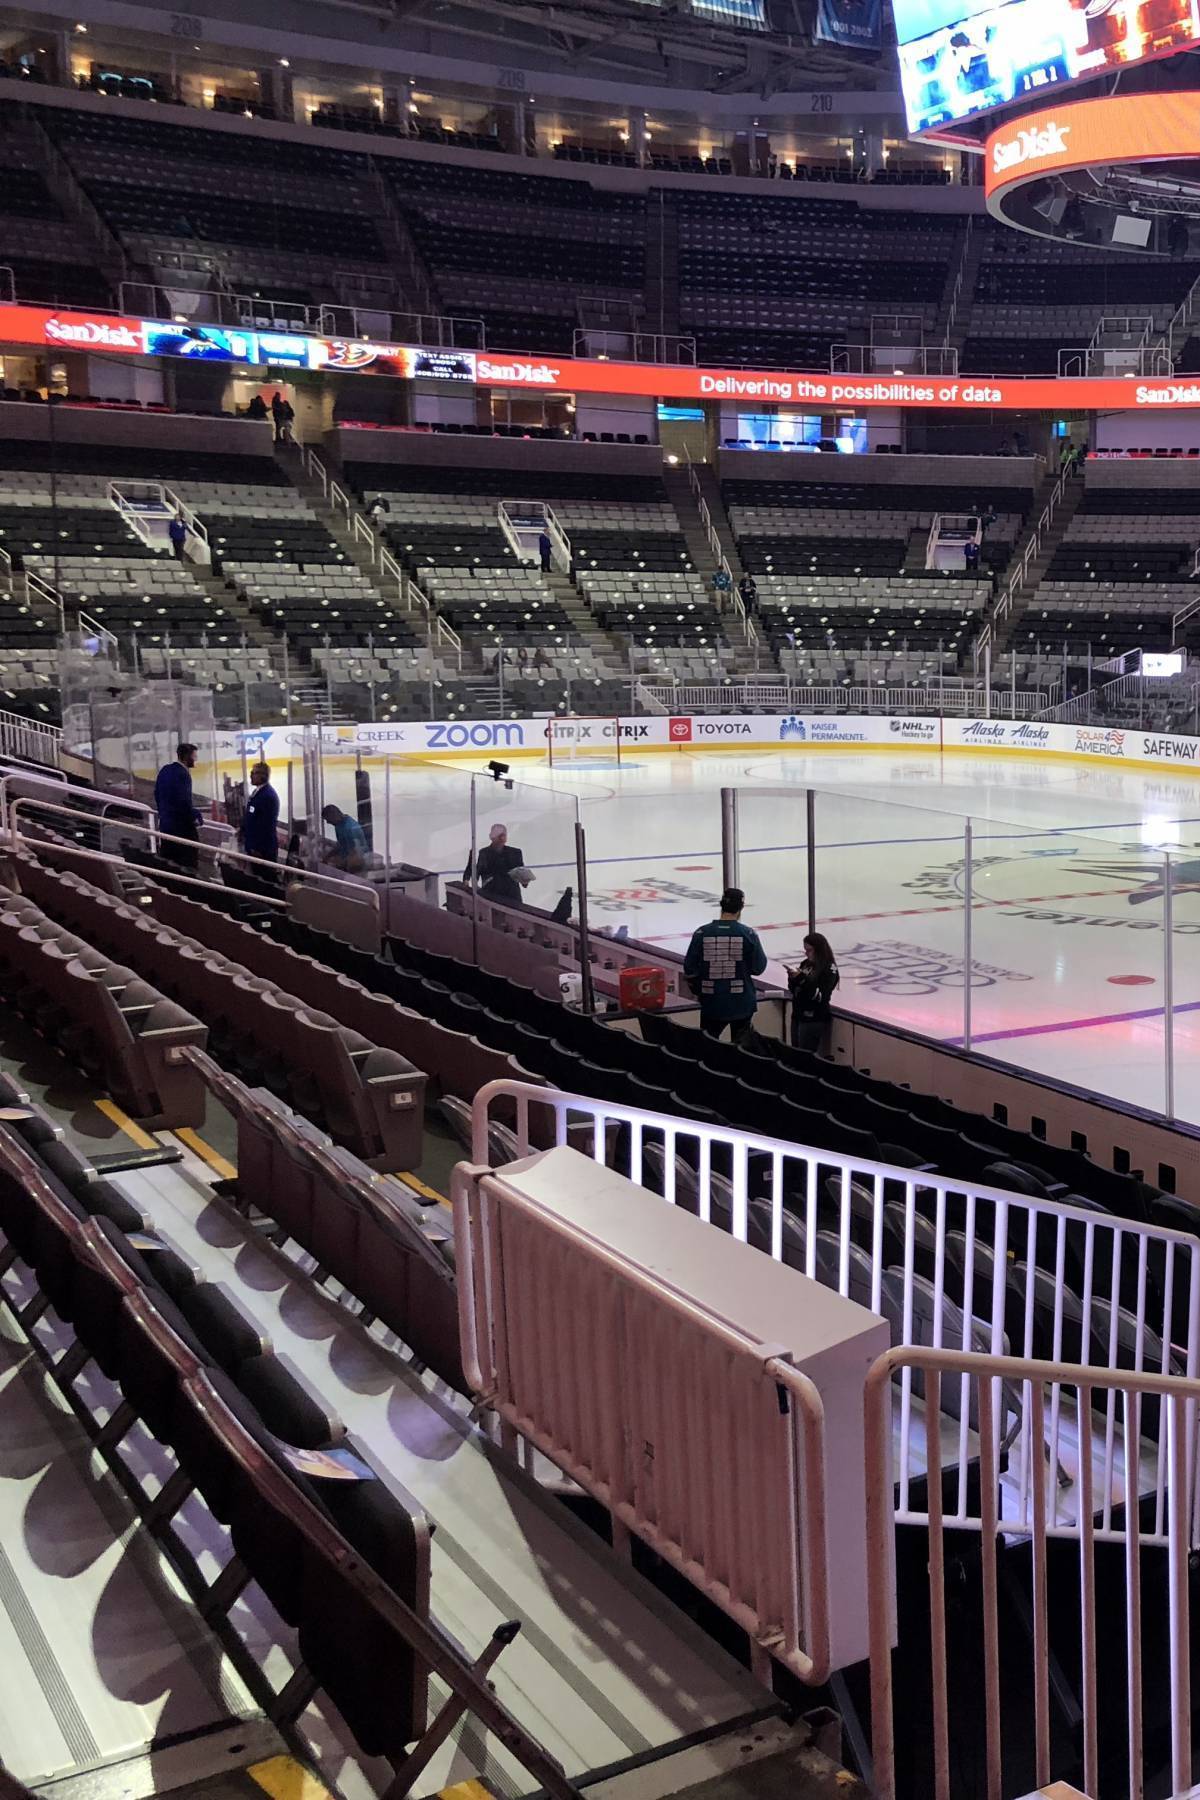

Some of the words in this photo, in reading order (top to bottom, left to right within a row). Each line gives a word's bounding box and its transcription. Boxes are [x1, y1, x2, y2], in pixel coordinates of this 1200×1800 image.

[811, 94, 833, 113] 210
[993, 122, 1069, 173] SanDisk
[45, 320, 141, 347] SanDisk
[478, 360, 558, 383] SanDisk
[700, 376, 791, 398] Delivering
[798, 380, 827, 397] the
[832, 384, 934, 401] possibilities
[939, 386, 958, 401] of
[962, 386, 1002, 402] data
[425, 723, 524, 747] zoom
[697, 723, 751, 734] TOYOTA
[811, 723, 838, 731] KAISER
[962, 721, 1005, 737] Alaska
[1011, 724, 1050, 740] Alaska
[357, 731, 405, 741] CREEK
[811, 732, 865, 741] PERMANENTE
[1076, 730, 1104, 741] SOLAR
[1075, 740, 1124, 756] AMERICA
[1144, 738, 1199, 760] SAFEWAY
[638, 980, 651, 994] G
